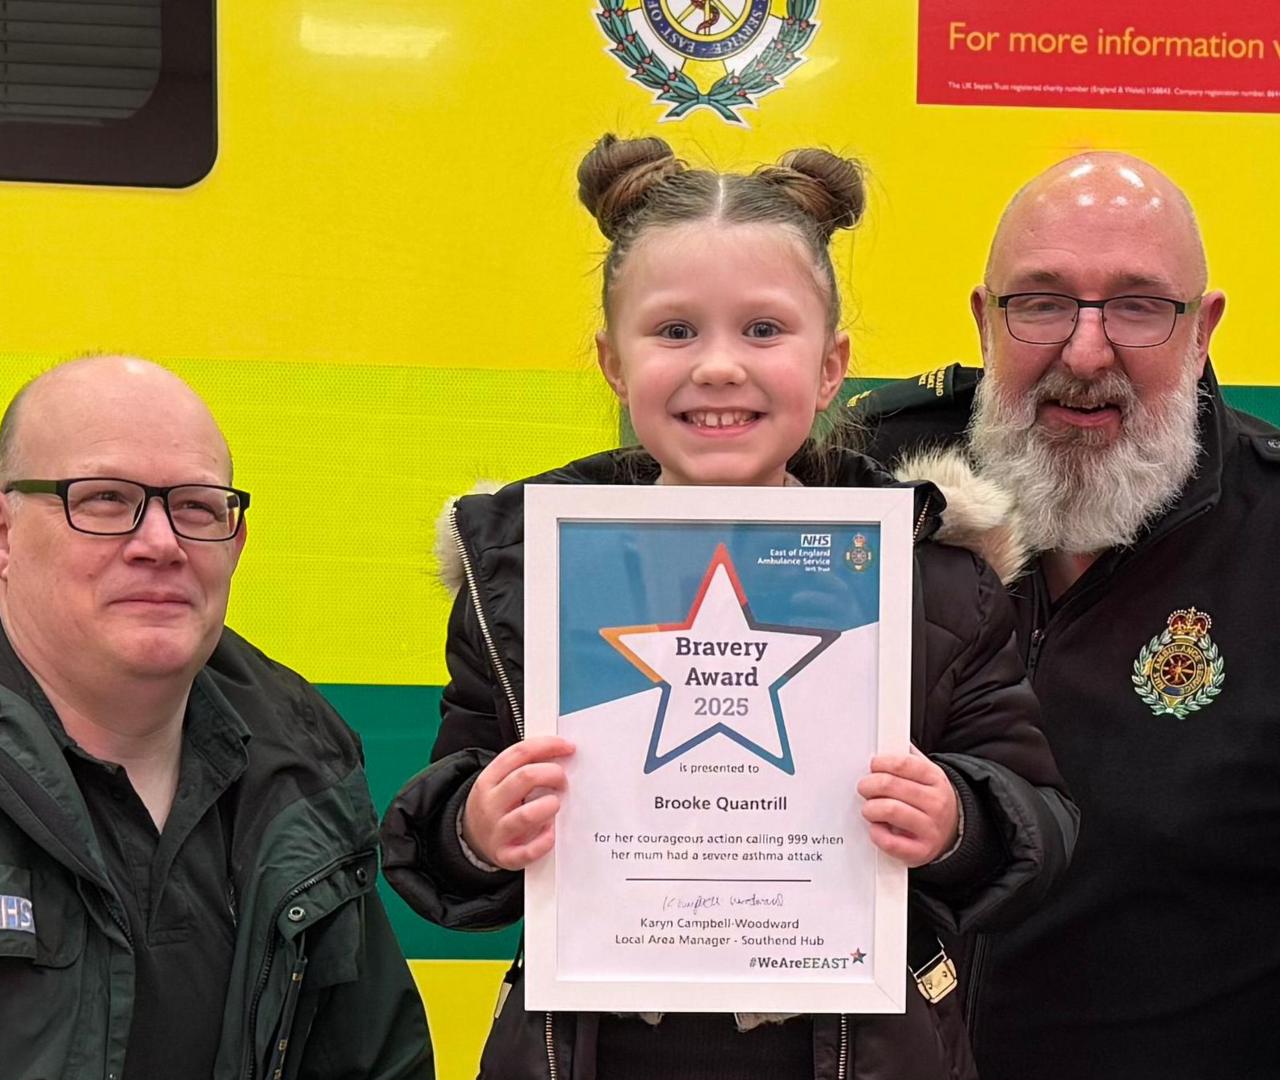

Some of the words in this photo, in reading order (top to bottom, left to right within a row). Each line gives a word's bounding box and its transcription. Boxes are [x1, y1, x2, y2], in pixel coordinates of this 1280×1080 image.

[712, 9, 764, 54] SERVICE
[659, 26, 696, 53] EAST
[948, 22, 1000, 51] For
[1009, 32, 1088, 54] more
[1097, 27, 1264, 59] information
[802, 534, 831, 547] NHS
[799, 549, 831, 558] England
[757, 557, 801, 566] Ambulance
[803, 558, 831, 566] Service
[675, 636, 768, 662] Bravery
[685, 666, 759, 687] Award
[694, 697, 749, 717] 2025
[680, 763, 687, 773] is
[690, 763, 744, 774] presented
[748, 764, 760, 774] to
[654, 795, 711, 810] Brooke
[716, 796, 787, 812] Quantrill
[594, 832, 611, 843] for
[615, 832, 634, 843] her
[637, 834, 704, 846] courageous
[707, 834, 743, 844] action
[746, 834, 784, 847] calling
[787, 834, 809, 845] 999
[811, 834, 844, 845] when
[611, 849, 630, 860] her
[634, 851, 663, 860] mum
[667, 849, 688, 860] had
[692, 852, 699, 860] a
[702, 852, 739, 861] severe
[742, 851, 784, 861] asthma
[787, 851, 823, 862] attack
[640, 918, 674, 930] Karyn
[677, 918, 800, 930] Campbell-Woodward
[615, 934, 645, 944] Local
[647, 934, 675, 944] Area
[678, 935, 730, 947] Manager
[741, 935, 797, 946] Southend
[800, 936, 825, 946] Hub
[749, 957, 850, 969] #WeAreEEAST
